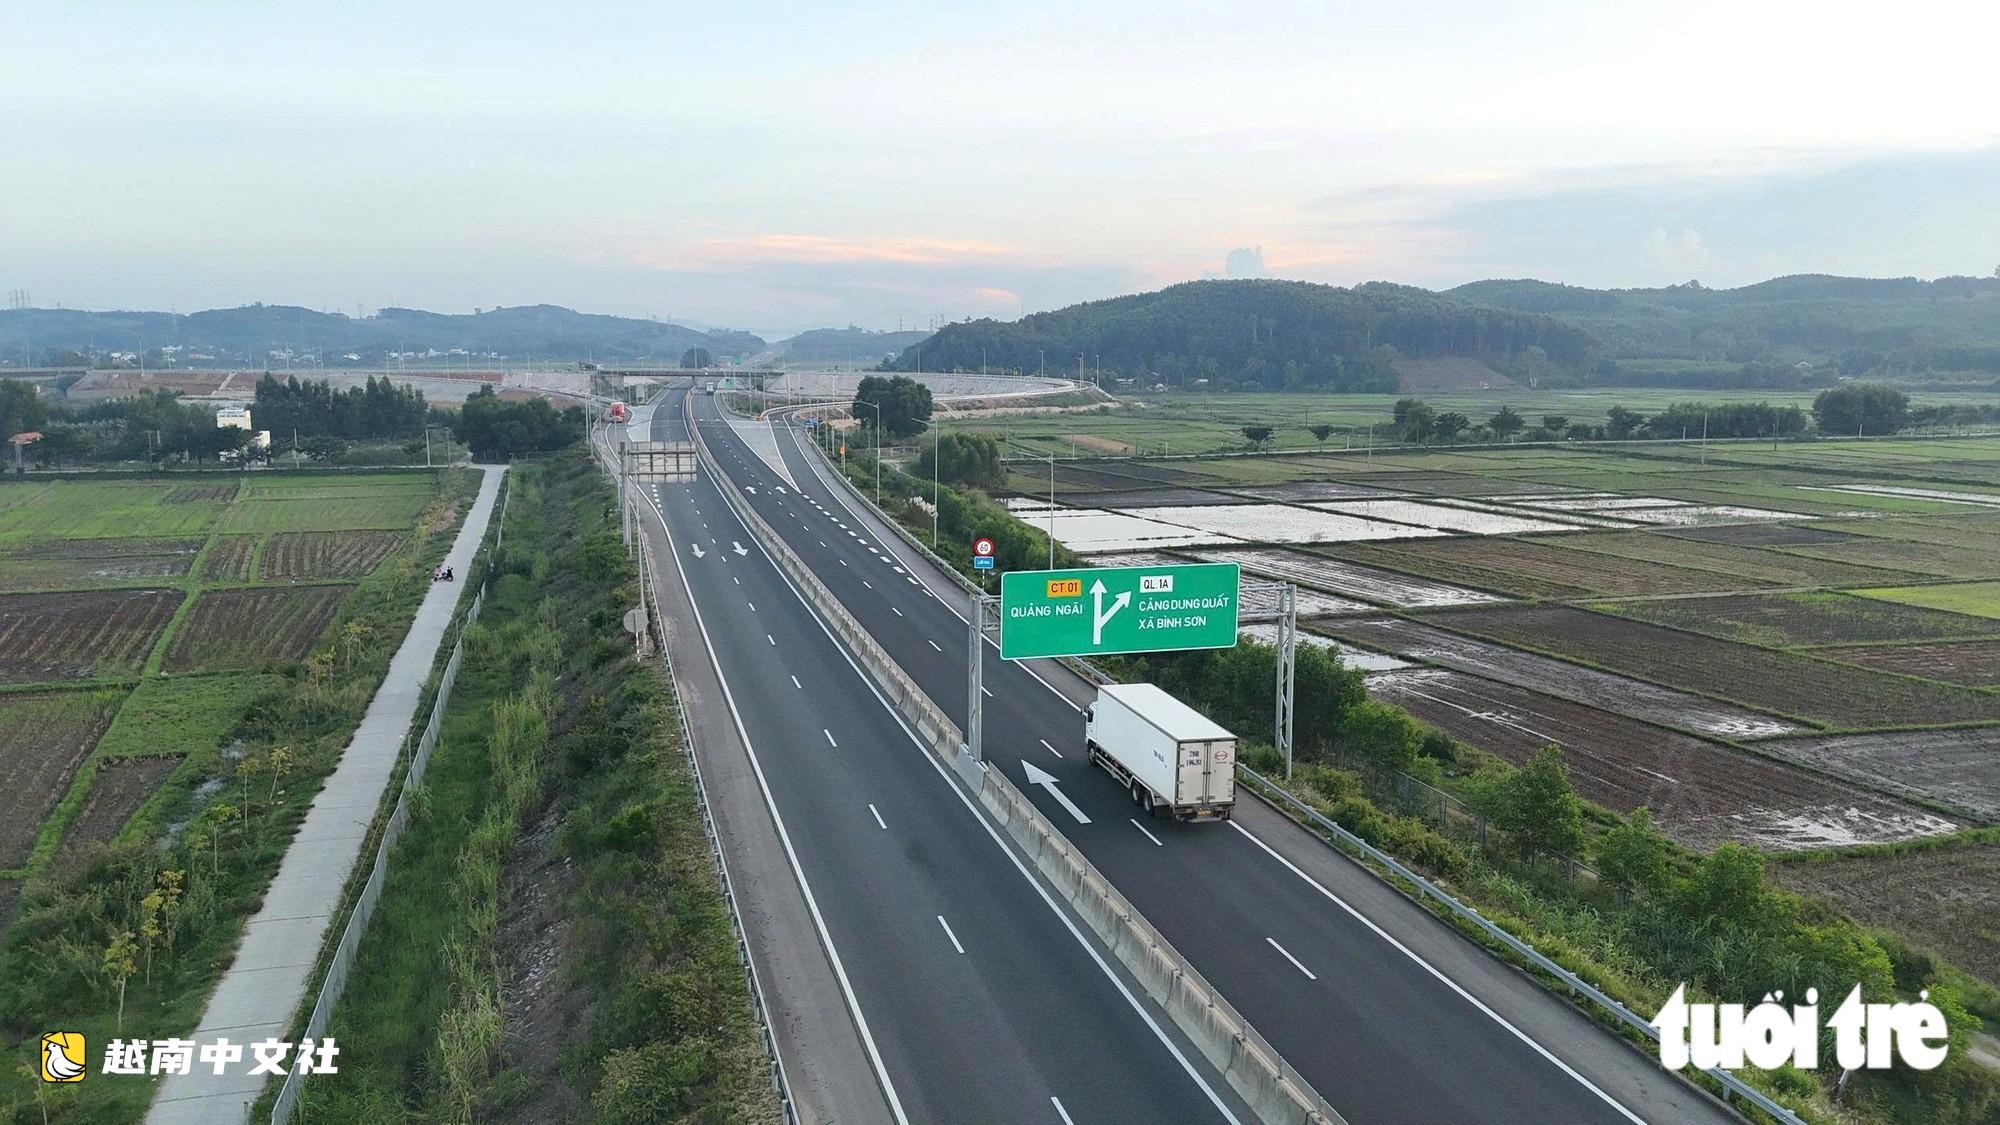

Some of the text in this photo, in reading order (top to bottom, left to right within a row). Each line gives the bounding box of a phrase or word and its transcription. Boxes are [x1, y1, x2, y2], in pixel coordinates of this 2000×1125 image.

[1050, 582, 1078, 593] CT.01
[1011, 601, 1083, 617] QUẢNG NGÃI
[1139, 594, 1230, 612] CẢNG DUNG QUẤT
[1138, 615, 1206, 629] XÃ BÌNH SƠN
